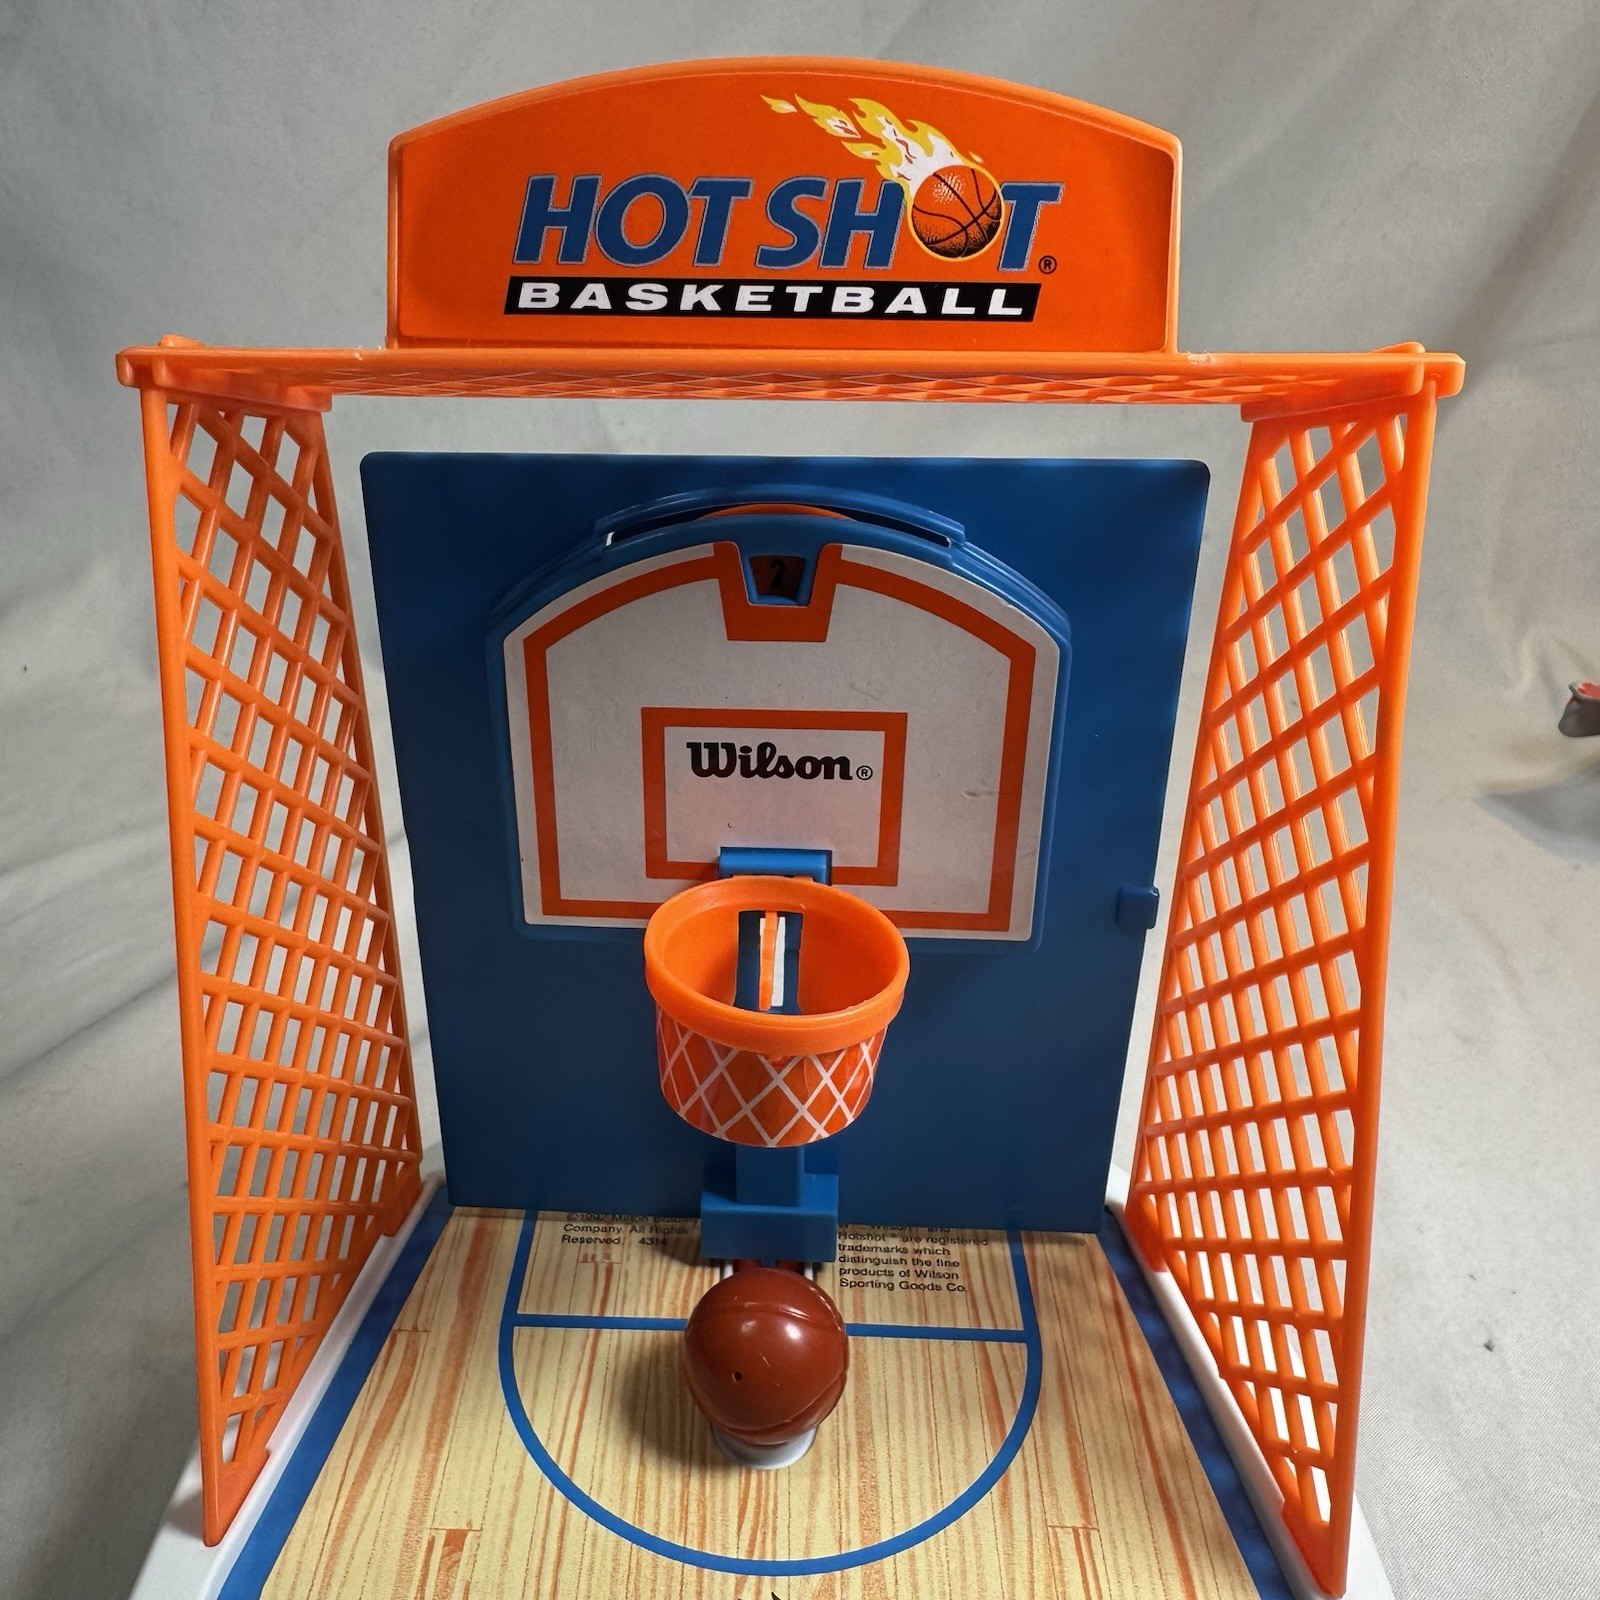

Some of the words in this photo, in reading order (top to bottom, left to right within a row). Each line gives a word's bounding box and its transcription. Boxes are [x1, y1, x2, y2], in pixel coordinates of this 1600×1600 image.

[512, 174, 754, 267] HOT
[518, 282, 1025, 316] BASKETBALL
[769, 558, 786, 591] 2
[901, 1235, 923, 1244] are
[925, 1236, 989, 1246] registered
[838, 1243, 909, 1254] trademarks
[913, 1246, 951, 1256] which
[838, 1255, 908, 1266] distinguish
[912, 1257, 932, 1267] the
[936, 1258, 960, 1268] fine
[839, 1267, 894, 1278] products
[898, 1268, 911, 1278] of
[915, 1269, 959, 1280] Wilson
[839, 1278, 895, 1291] Sporting
[899, 1281, 942, 1292] Goods
